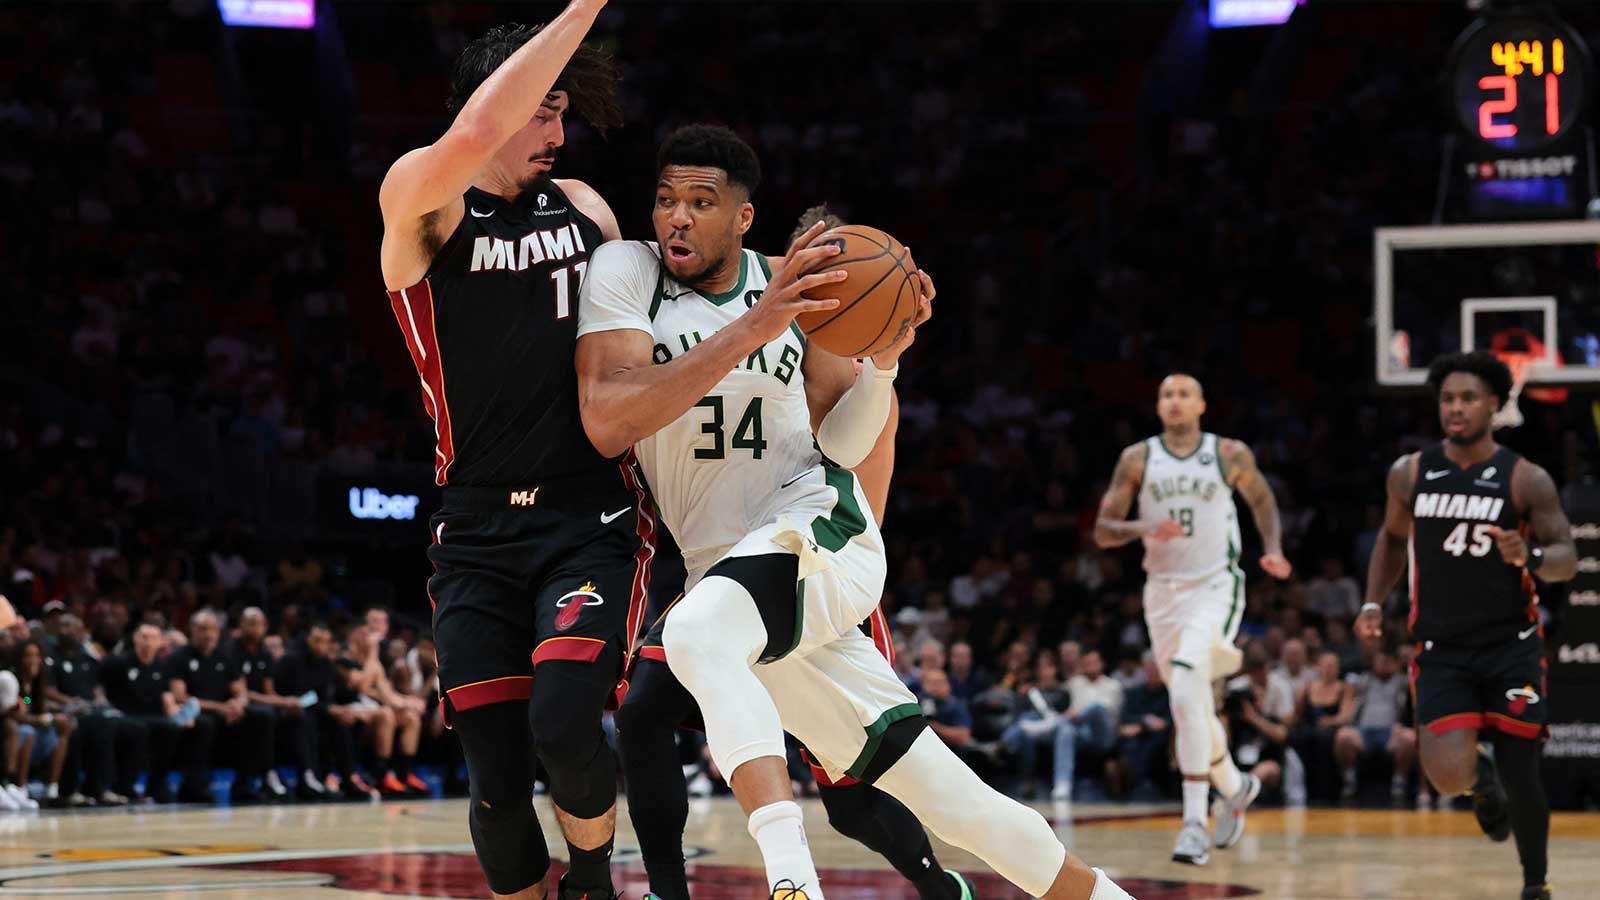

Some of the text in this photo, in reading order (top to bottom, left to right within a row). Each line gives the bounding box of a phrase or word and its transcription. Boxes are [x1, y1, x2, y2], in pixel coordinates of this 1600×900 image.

[1478, 73, 1560, 139] 21
[470, 221, 586, 272] MIAMI
[693, 394, 769, 460] 34
[349, 486, 420, 520] Uber
[1148, 474, 1218, 503] BUCKS
[1414, 492, 1505, 522] MIAMI
[1443, 522, 1494, 557] 45
